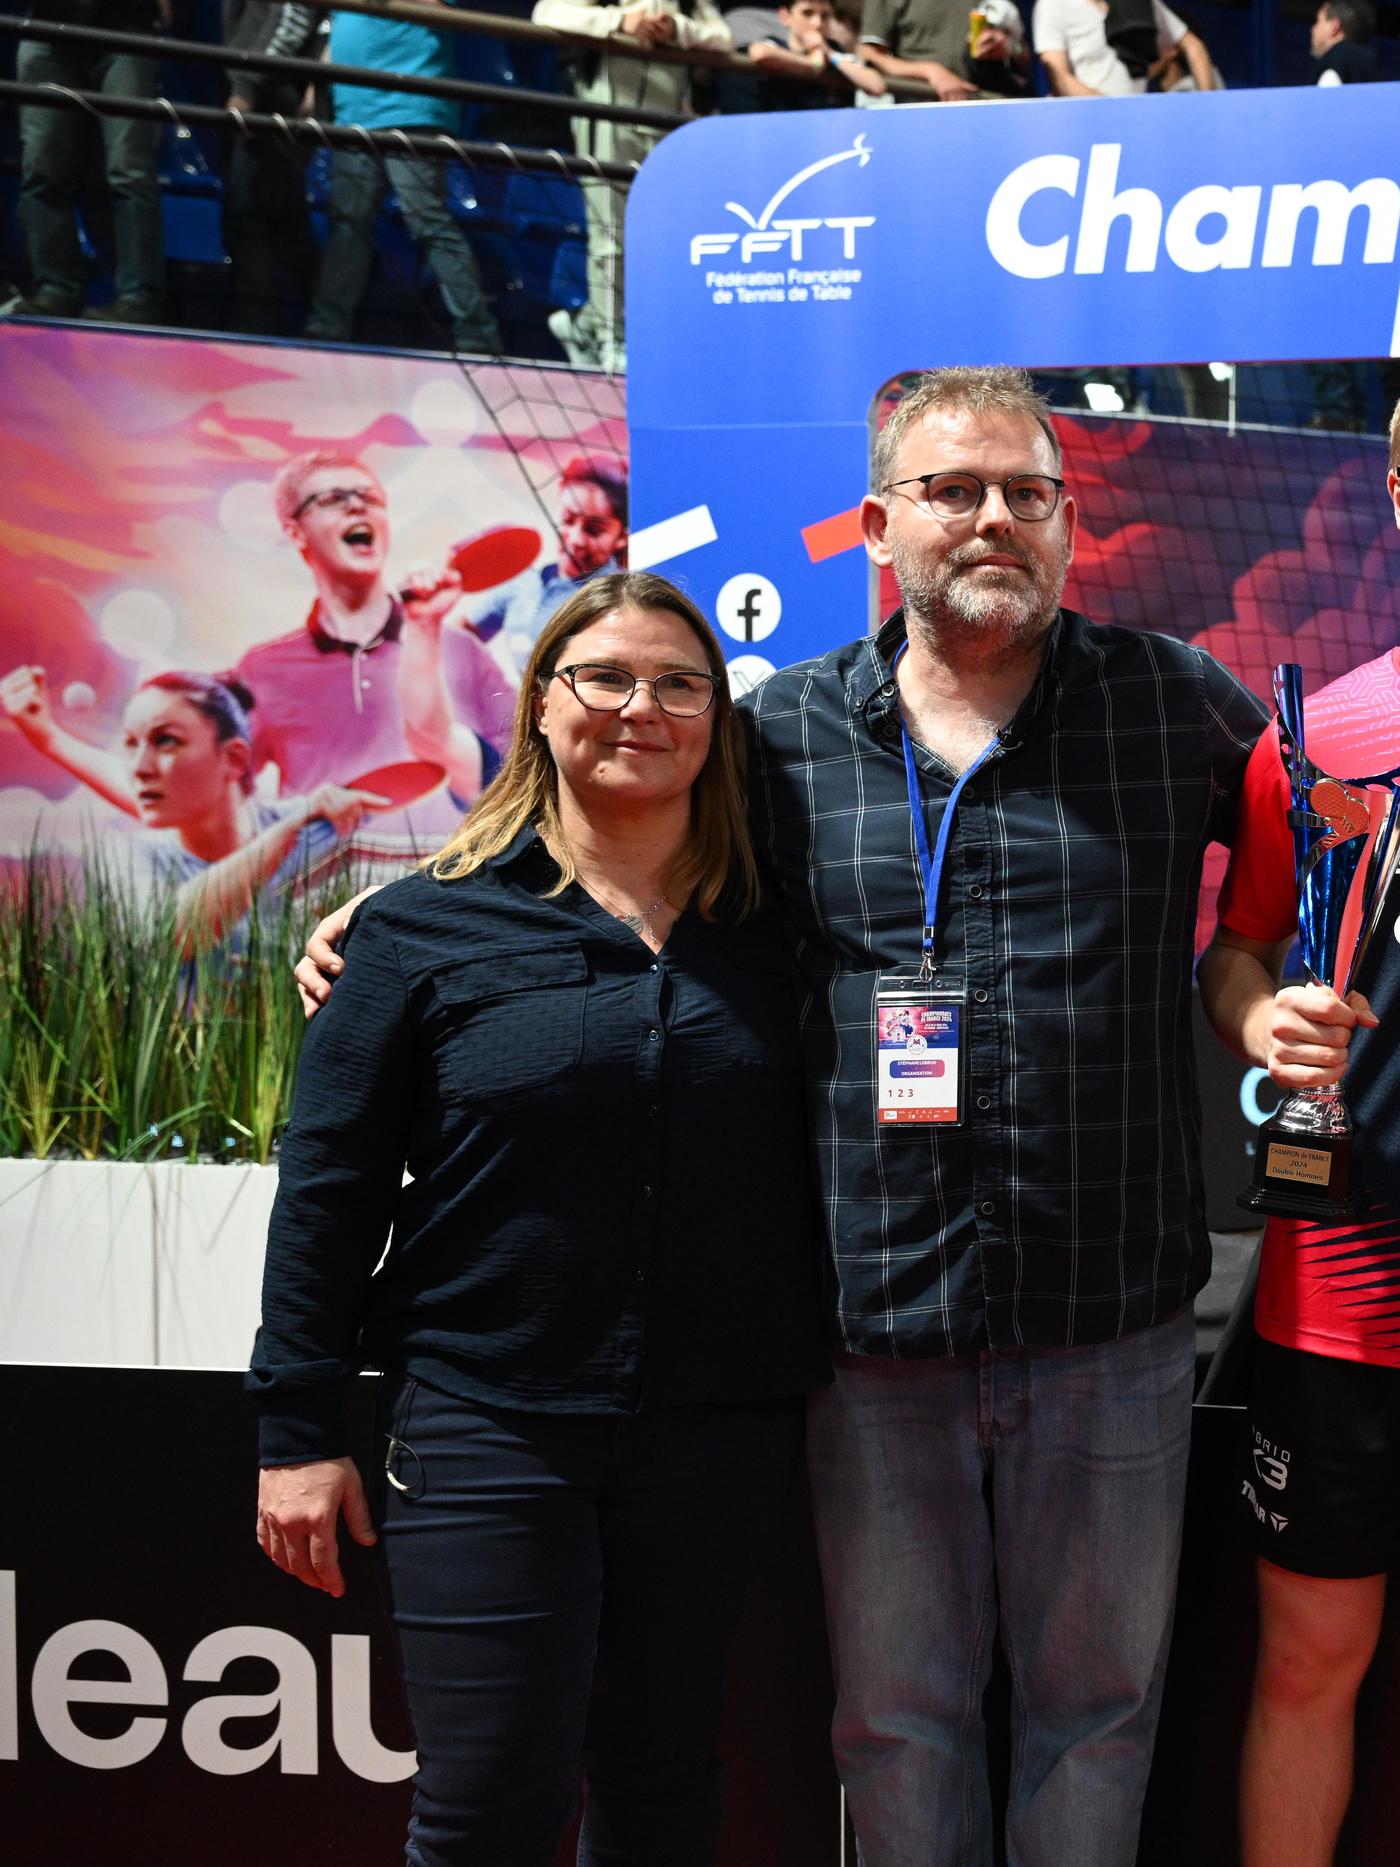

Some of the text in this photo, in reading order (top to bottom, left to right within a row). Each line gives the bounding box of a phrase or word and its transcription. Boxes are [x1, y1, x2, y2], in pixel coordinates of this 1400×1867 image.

[690, 216, 876, 266] FFTT
[713, 284, 852, 304] de Tennis de Table
[898, 1089, 903, 1097] 2
[908, 1088, 913, 1097] 3
[1270, 1148, 1300, 1157] CHAMPION
[1309, 1154, 1329, 1162] FRANCE
[1290, 1160, 1307, 1168] 2024
[1272, 1166, 1323, 1180] Double Hommes
